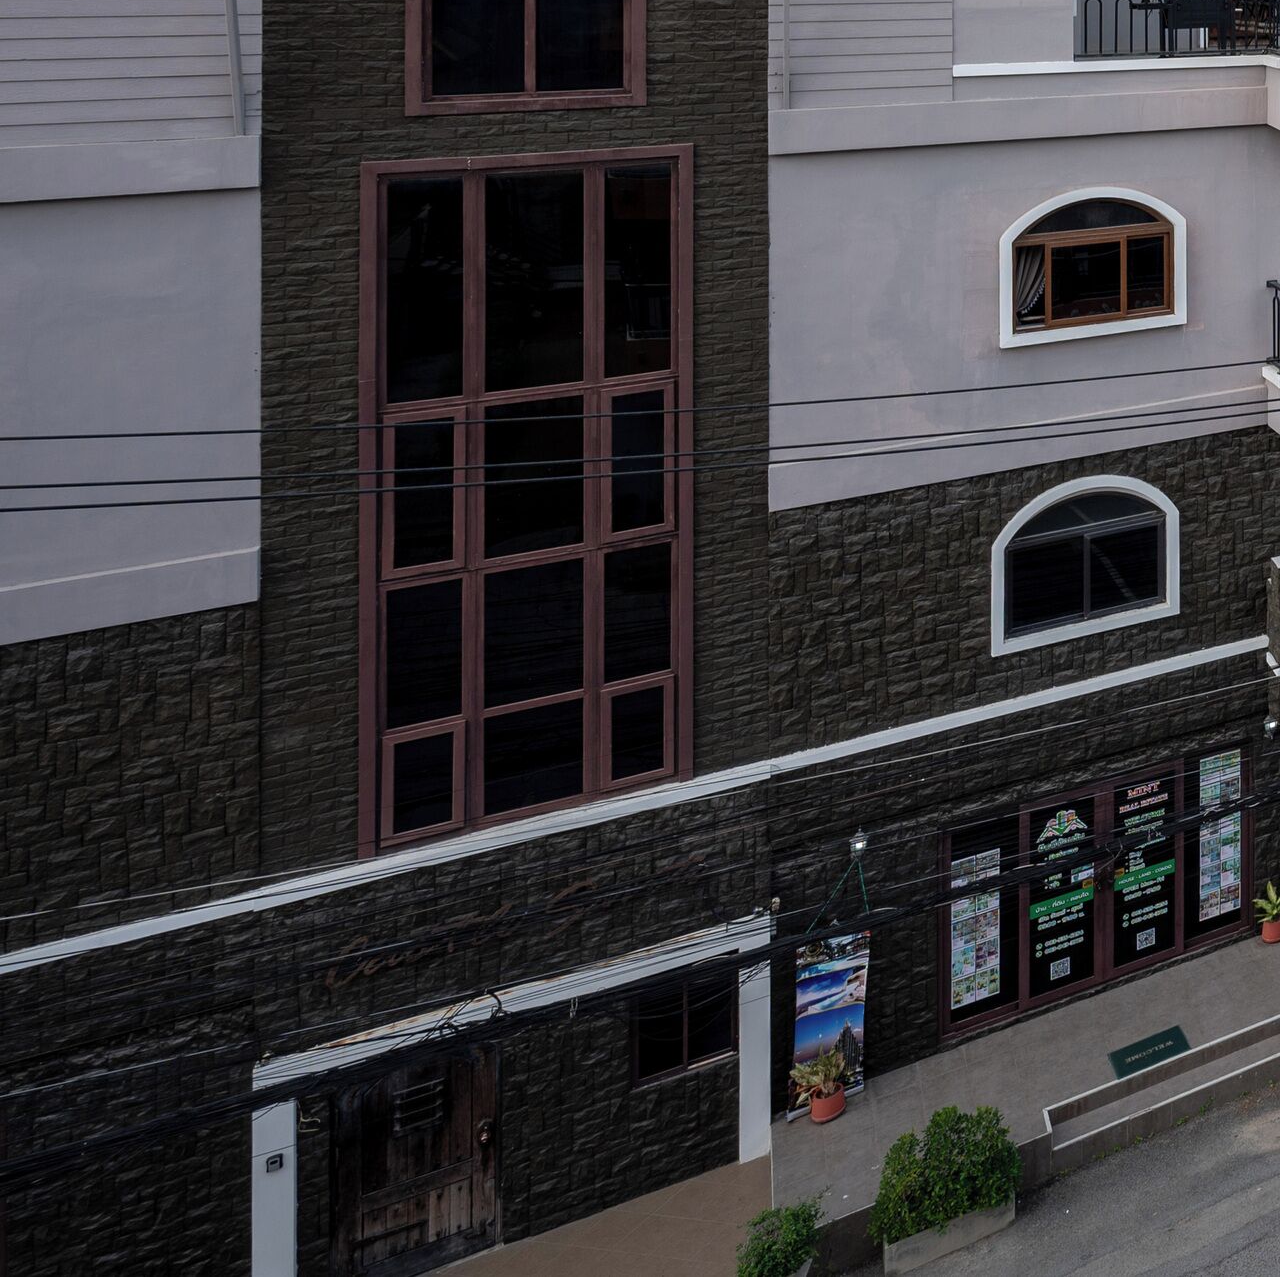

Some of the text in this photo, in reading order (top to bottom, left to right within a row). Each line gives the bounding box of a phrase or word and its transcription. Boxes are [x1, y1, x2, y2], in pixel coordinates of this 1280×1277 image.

[1118, 876, 1135, 885] HOUSE
[1154, 864, 1172, 873] CONDO
[1124, 1039, 1175, 1065] WELCOME
